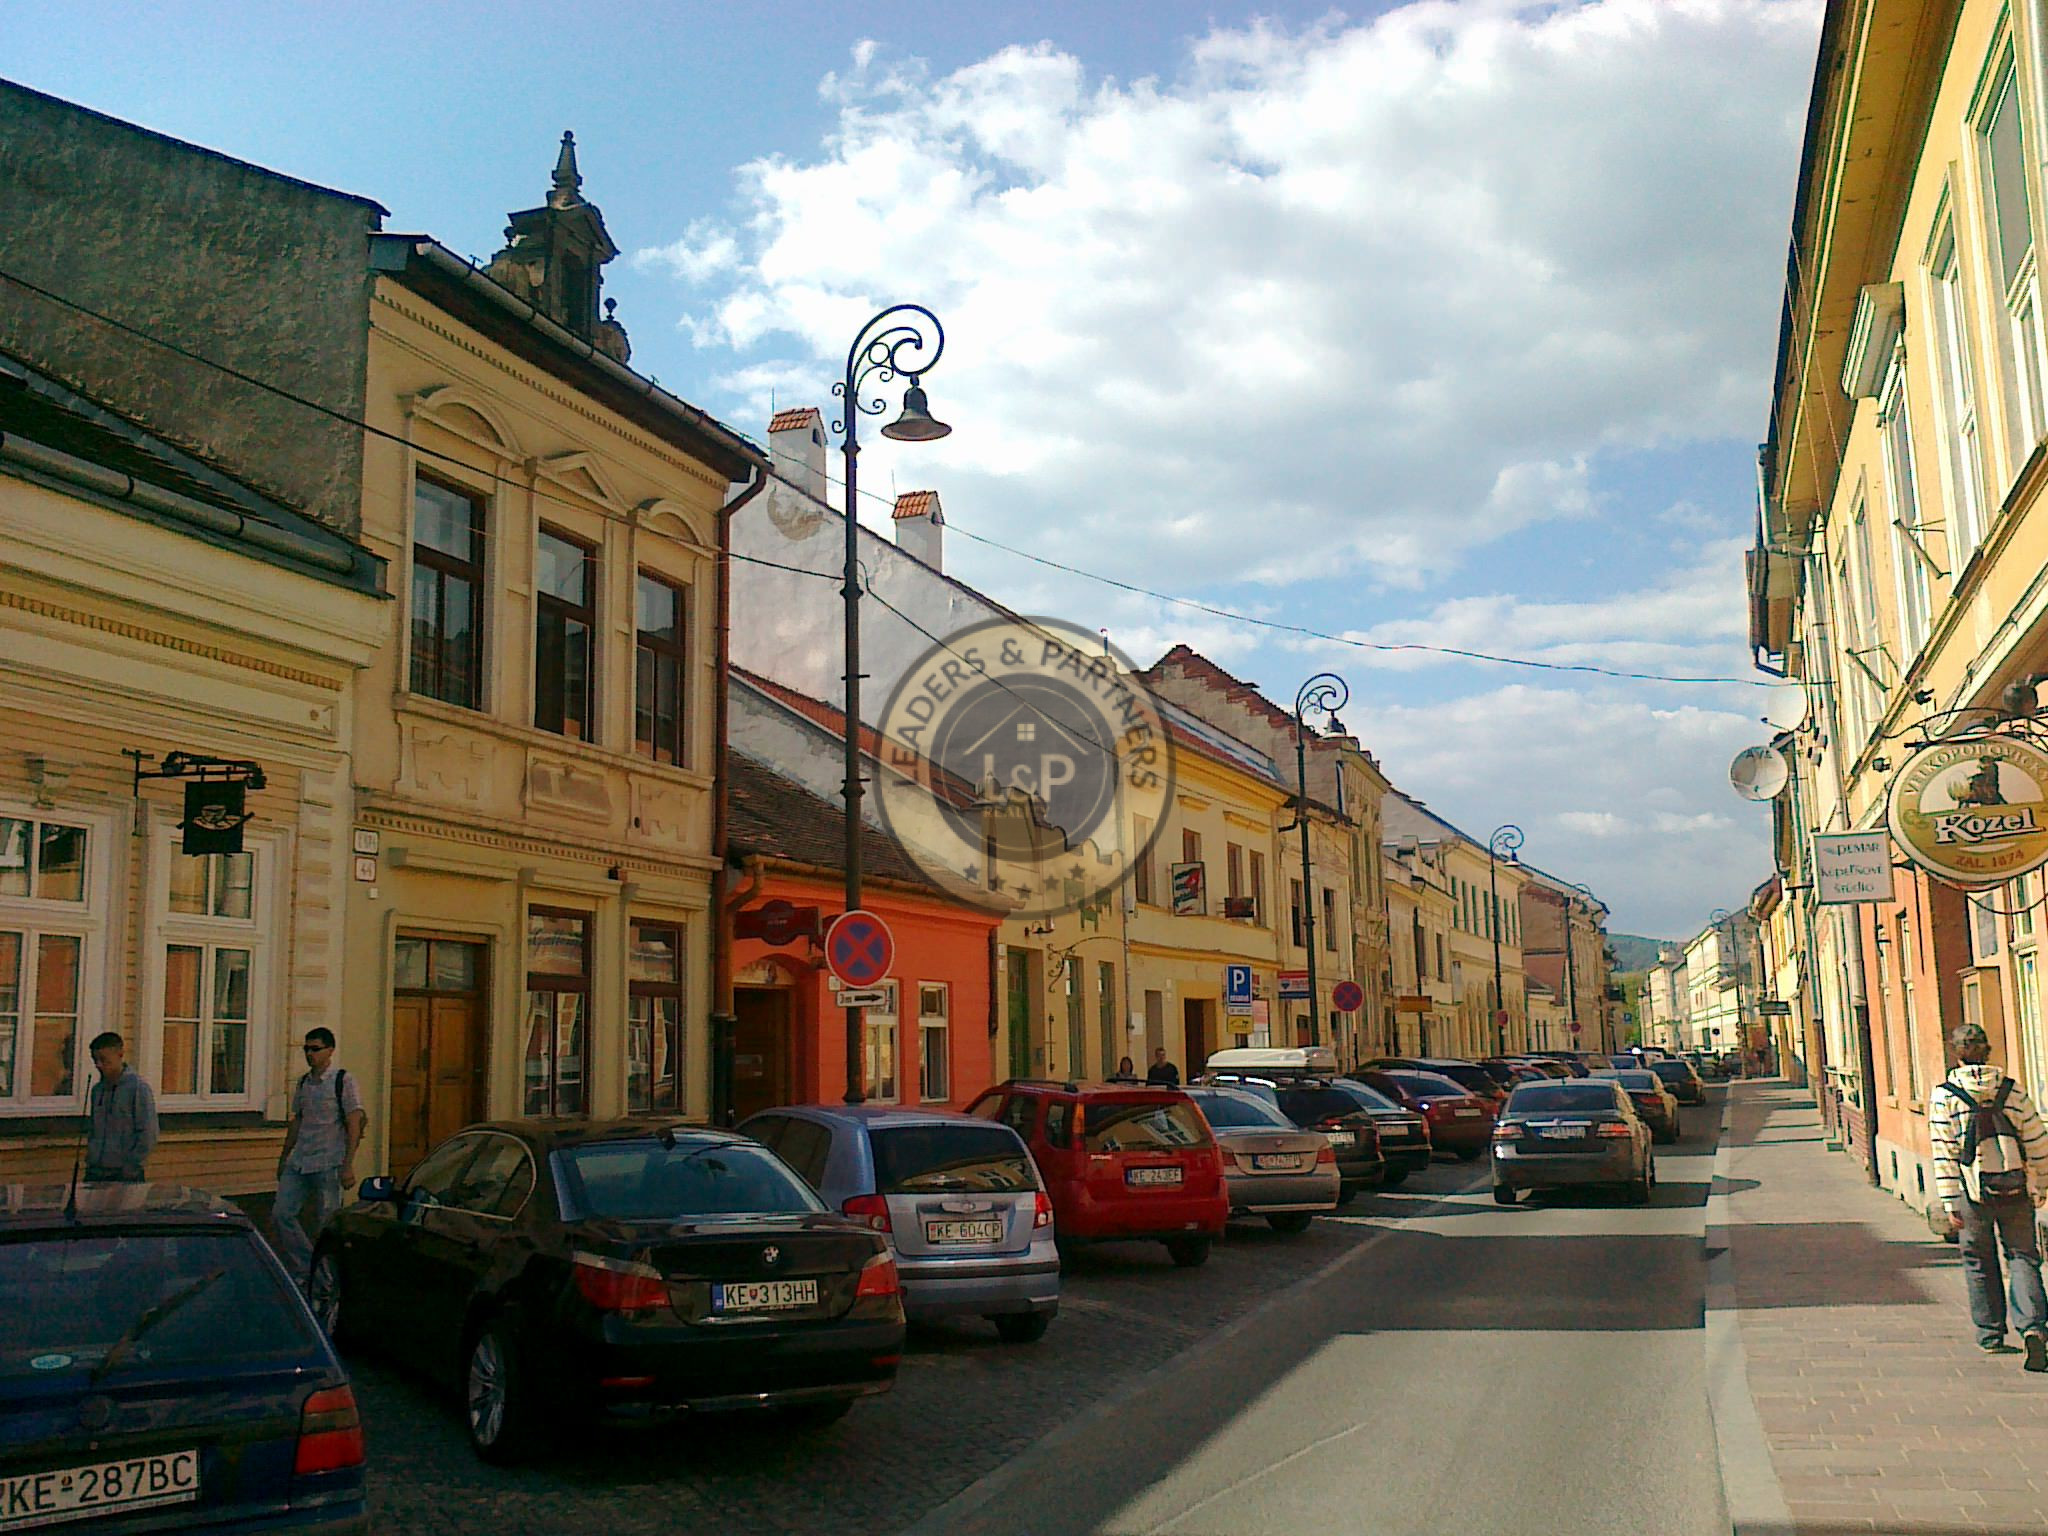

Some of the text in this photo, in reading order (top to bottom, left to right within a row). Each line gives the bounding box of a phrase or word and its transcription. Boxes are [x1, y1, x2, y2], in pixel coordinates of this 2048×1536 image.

[1935, 807, 2037, 844] Kozel
[1233, 968, 1246, 993] P
[725, 1282, 816, 1306] KE 313HH
